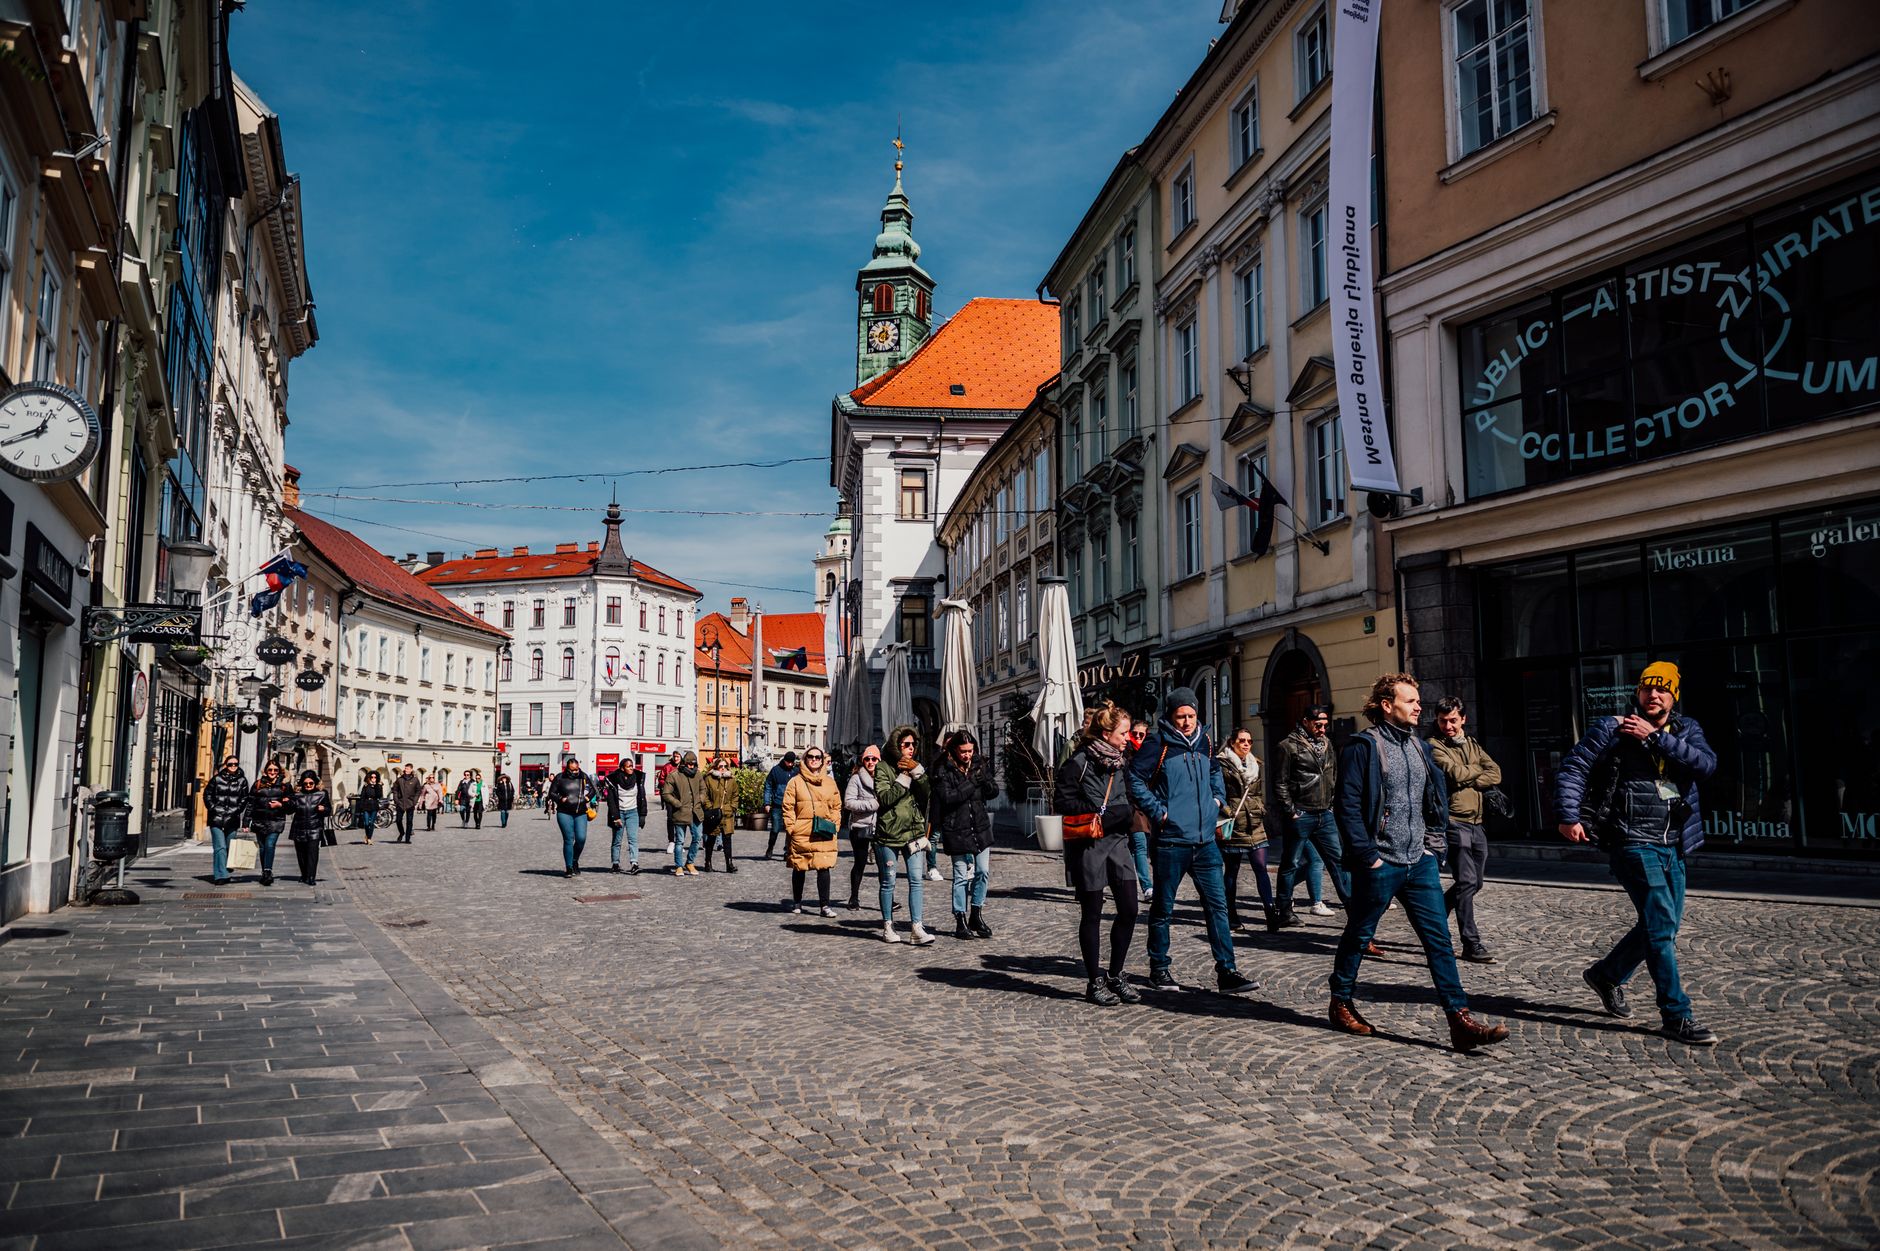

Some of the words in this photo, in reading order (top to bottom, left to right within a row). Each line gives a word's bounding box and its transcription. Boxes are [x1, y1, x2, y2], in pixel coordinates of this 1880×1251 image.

[1591, 262, 1720, 319] ARTIST
[1472, 318, 1549, 432] PUBLIC
[1519, 382, 1736, 461] COLLECTOR
[1652, 545, 1737, 573] Mestna
[1077, 652, 1142, 689] OTOVŽ
[1703, 810, 1792, 844] ubljana
